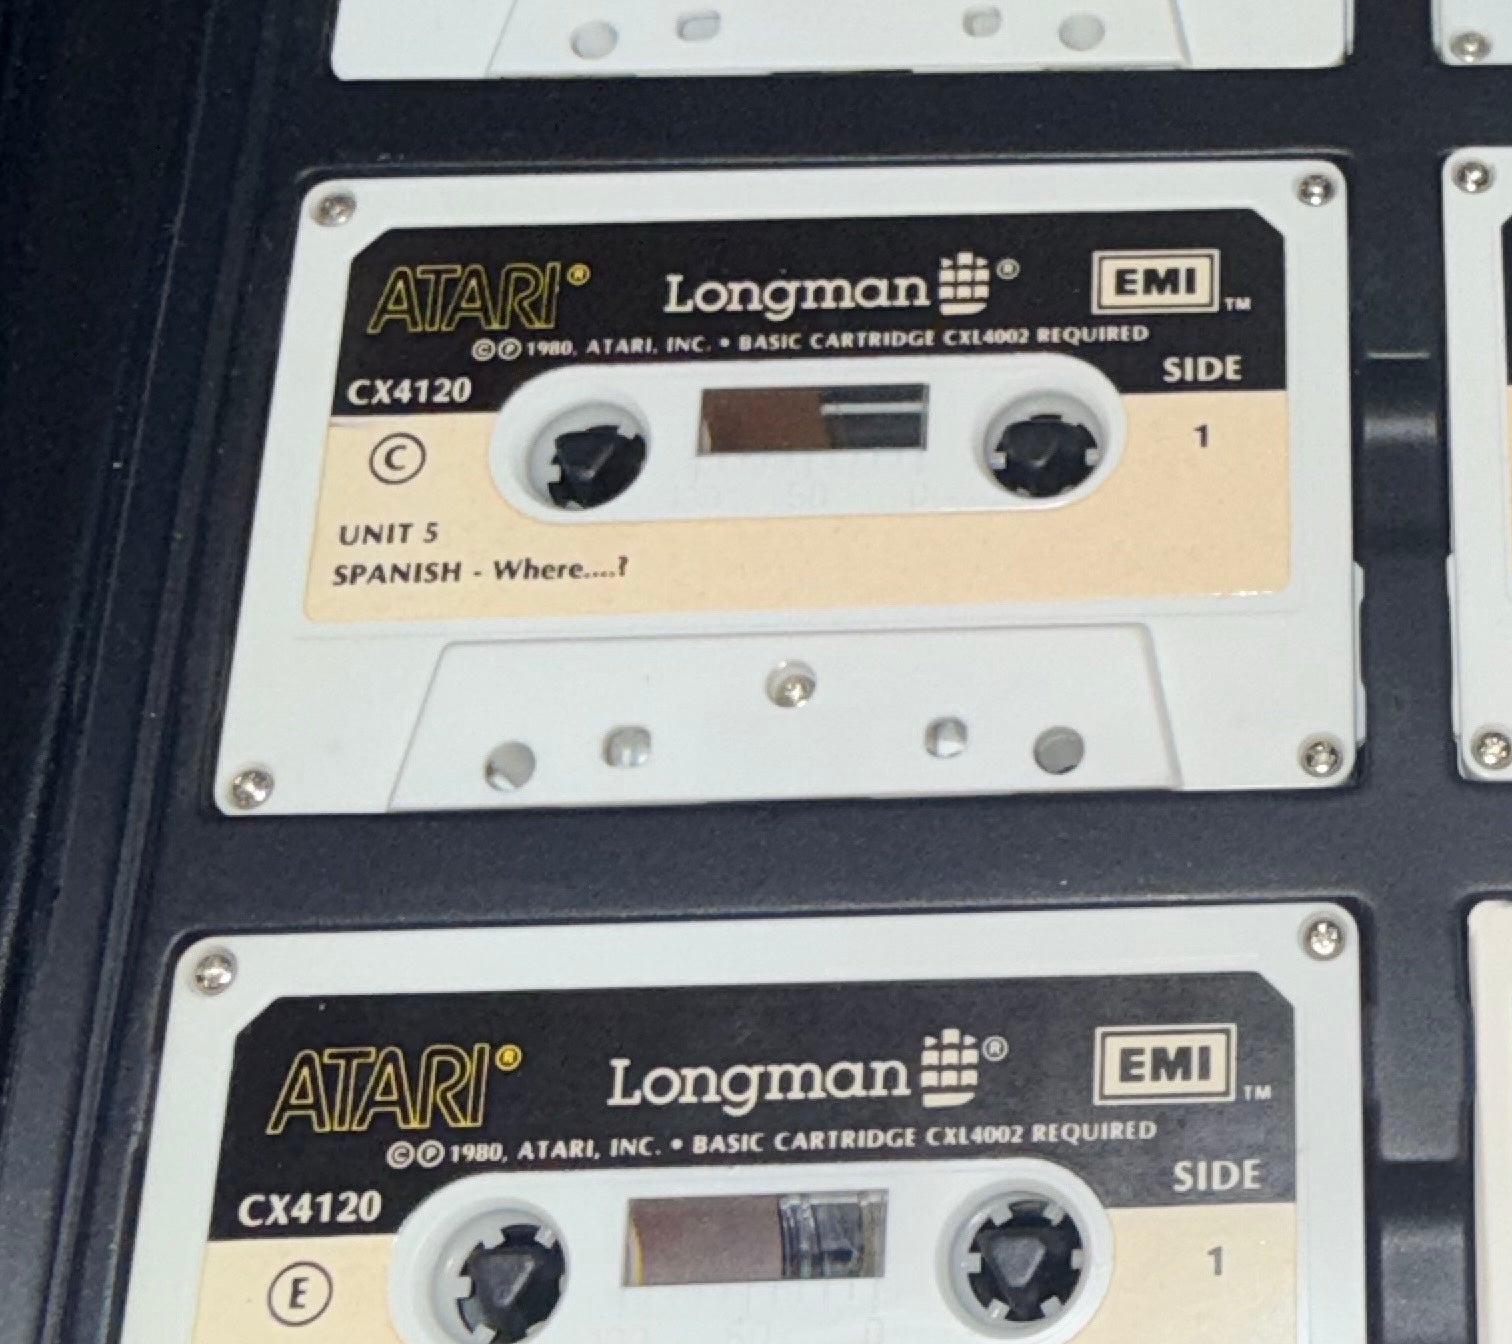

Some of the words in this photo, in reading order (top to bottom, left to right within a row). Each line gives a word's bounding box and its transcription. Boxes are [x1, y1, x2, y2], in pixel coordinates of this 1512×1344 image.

[1115, 268, 1195, 295] EMI
[663, 274, 931, 321] Longman
[739, 333, 801, 351] BASIC
[810, 330, 934, 349] CARTRIDGE
[943, 329, 1029, 345] CXL4002
[1037, 325, 1149, 345] REQUIRED
[1163, 355, 1241, 382] SIDE
[347, 377, 471, 405] CX4120
[1195, 425, 1207, 447] 1
[339, 523, 413, 545] UNIT
[423, 522, 438, 543] 5
[333, 562, 461, 585] SPANISH
[1120, 1047, 1210, 1082] EMI
[607, 1059, 911, 1117] Longman
[693, 1133, 763, 1153] BASIC
[774, 1128, 915, 1151] CARTRIDGE
[926, 1125, 1023, 1145] CXL4002
[1032, 1121, 1157, 1145] REQUIRED
[1170, 1159, 1261, 1191] SIDE
[239, 1191, 381, 1227] CX4120
[1207, 1246, 1223, 1276] 1
